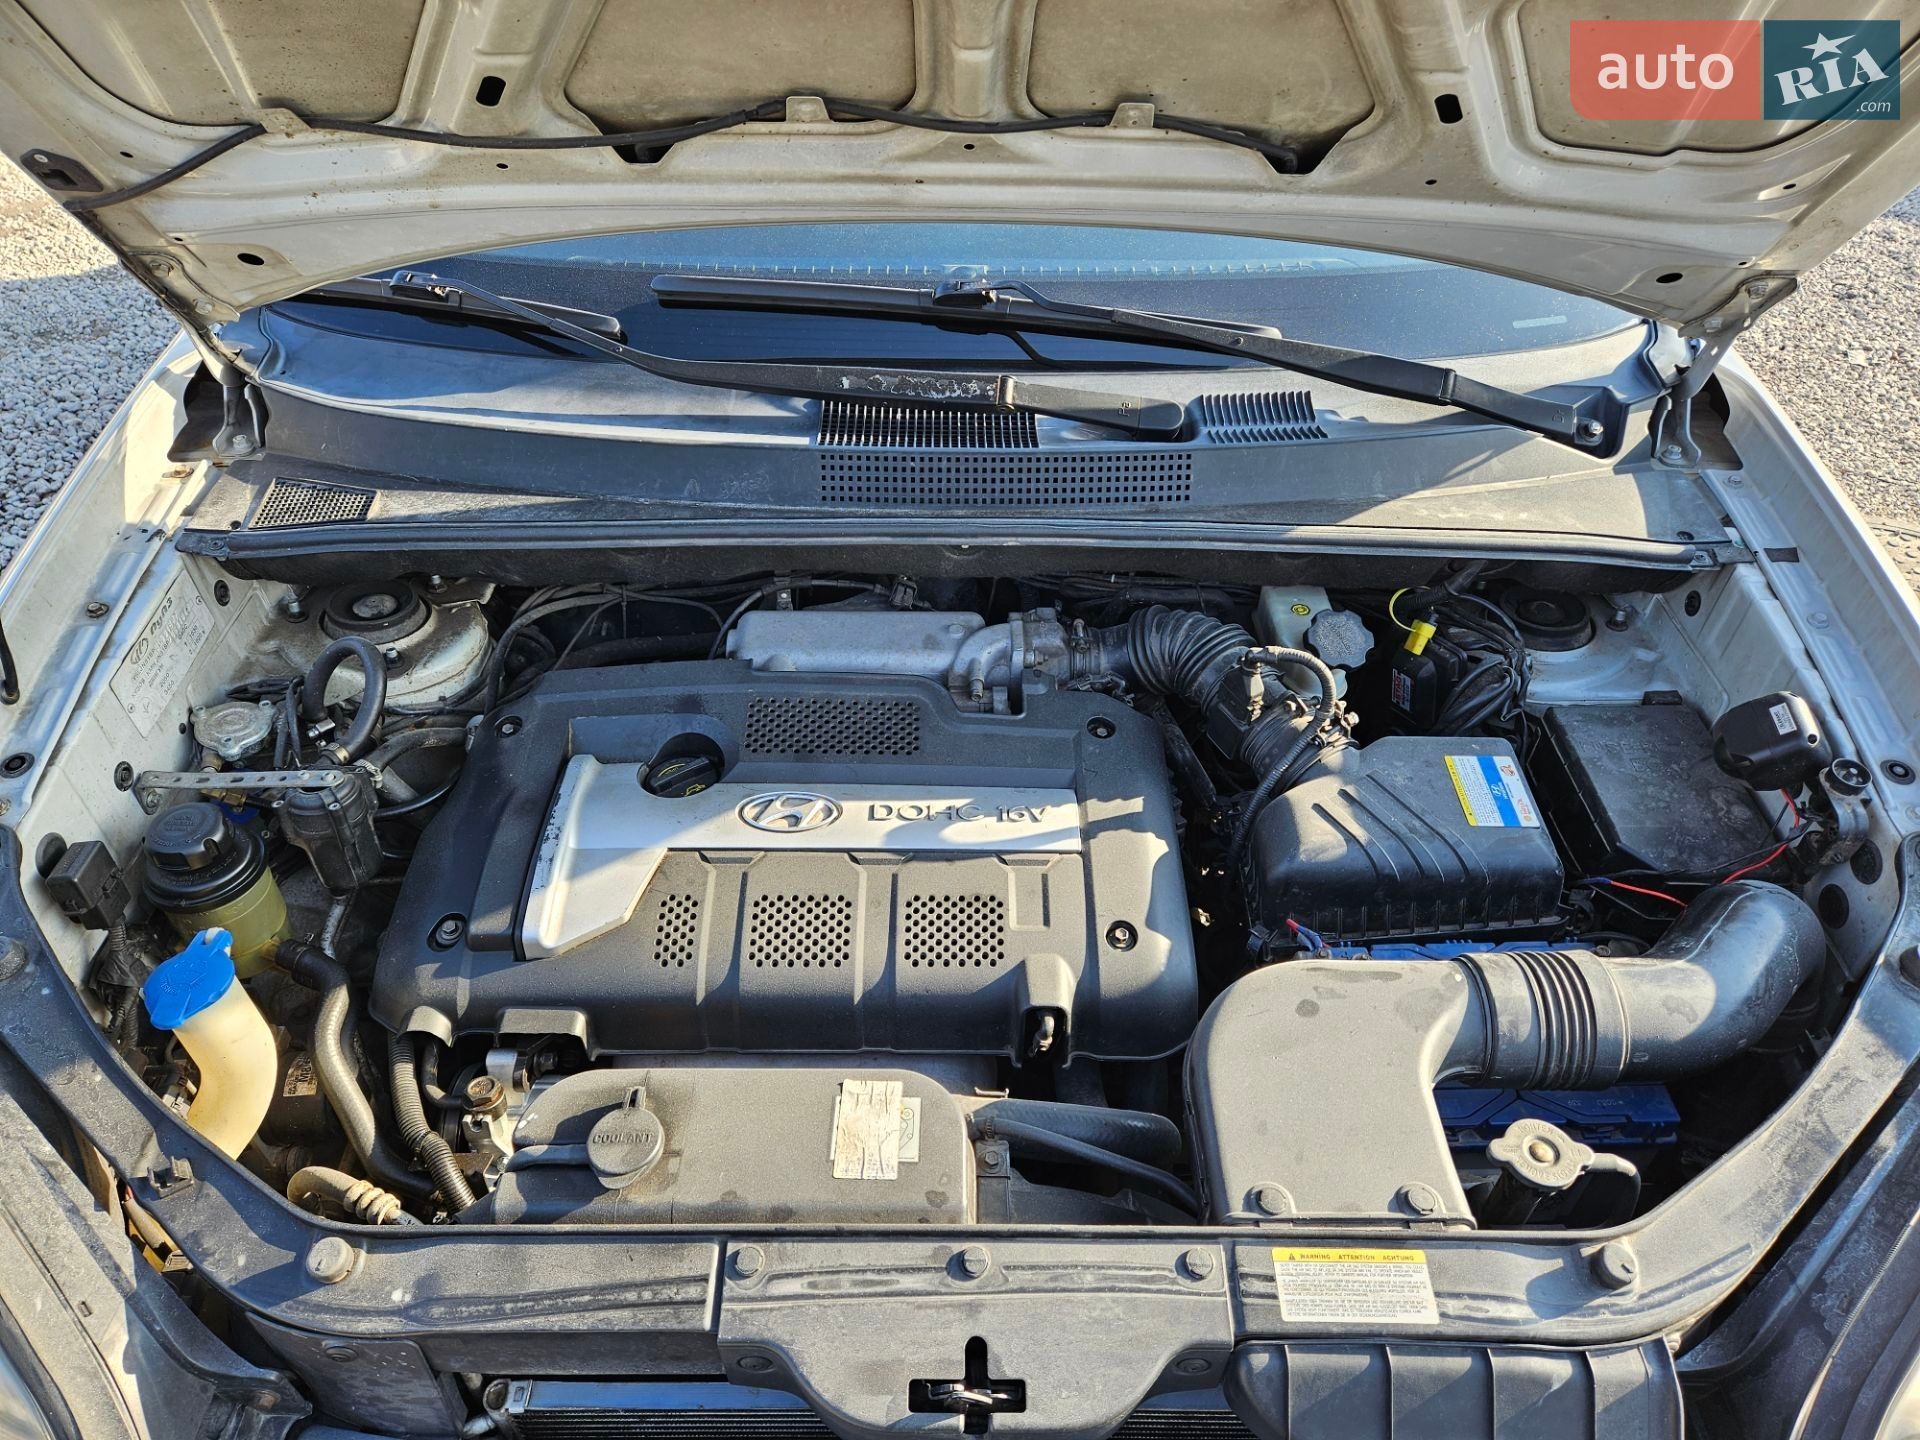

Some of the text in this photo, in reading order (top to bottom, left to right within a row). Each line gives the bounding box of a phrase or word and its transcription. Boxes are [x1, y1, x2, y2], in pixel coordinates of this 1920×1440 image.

[867, 804, 1048, 822] DOHC 16V
[592, 1132, 654, 1145] COOLANT
[1338, 1253, 1375, 1261] ATTENTION
[1382, 1254, 1414, 1262] ACHTUNG
